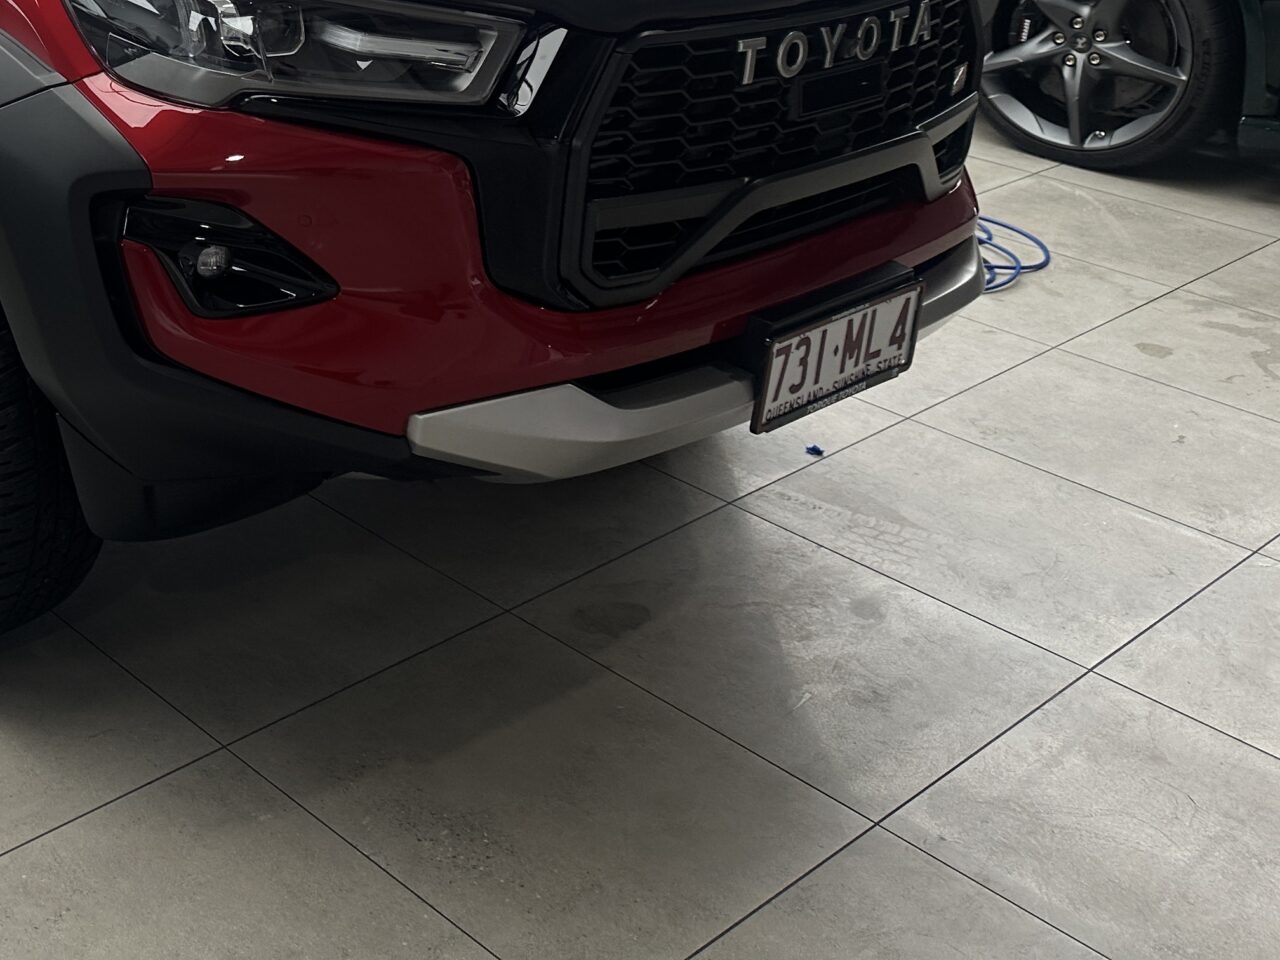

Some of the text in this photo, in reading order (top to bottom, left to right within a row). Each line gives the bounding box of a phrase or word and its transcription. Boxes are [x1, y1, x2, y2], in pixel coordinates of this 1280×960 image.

[737, 0, 932, 86] TOYOTA
[765, 386, 824, 421] QUEENSLAND
[832, 363, 871, 391] SUNSHINE
[876, 352, 904, 372] STATE
[837, 381, 867, 401] TOYOTA
